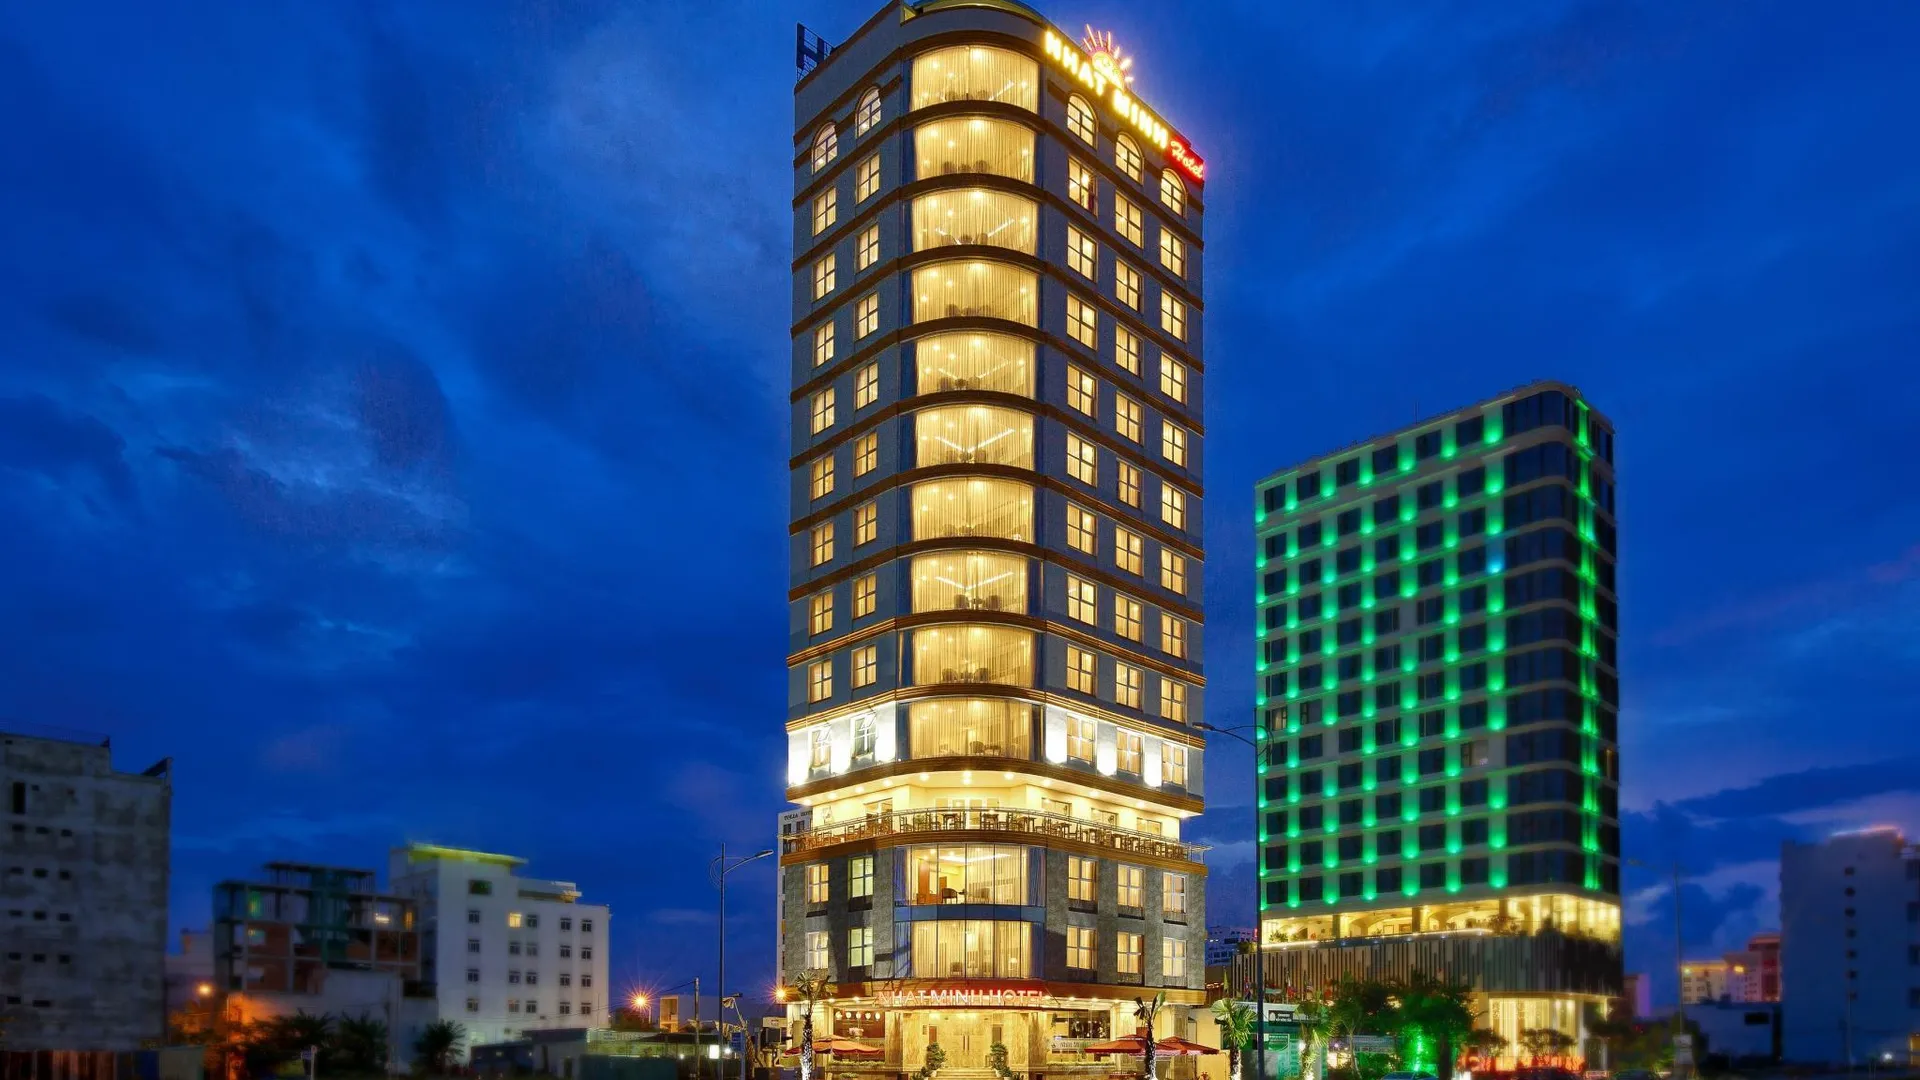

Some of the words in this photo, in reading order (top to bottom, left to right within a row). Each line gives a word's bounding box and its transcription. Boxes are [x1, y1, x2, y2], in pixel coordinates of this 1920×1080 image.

[1044, 30, 1107, 97] NHAT
[1113, 89, 1169, 149] MINH
[1170, 140, 1204, 178] Hotel
[878, 989, 927, 1005] NHAT
[930, 988, 983, 1005] MINH
[989, 989, 1044, 1005] HOTEL
